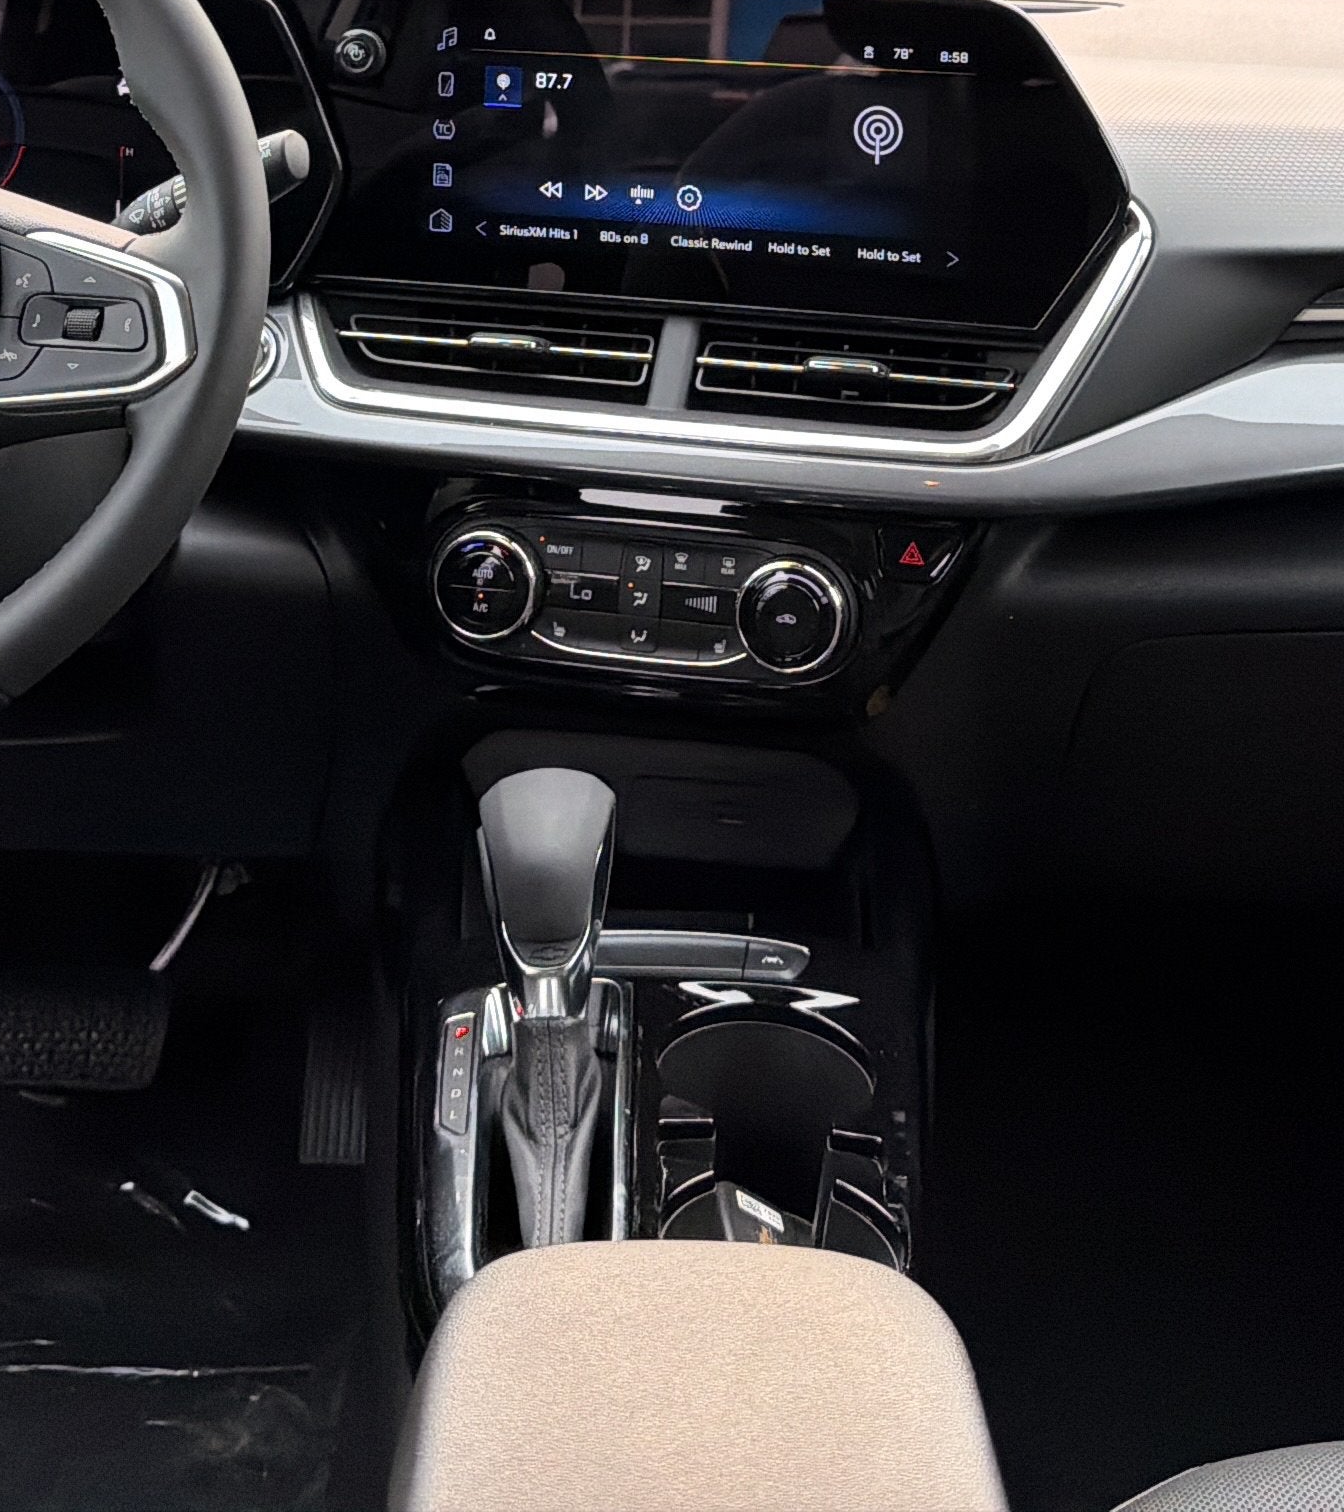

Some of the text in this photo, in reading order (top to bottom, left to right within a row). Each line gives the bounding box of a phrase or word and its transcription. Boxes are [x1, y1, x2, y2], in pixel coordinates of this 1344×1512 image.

[939, 51, 969, 64] 8:58
[535, 72, 573, 90] 87.7
[125, 147, 134, 157] H
[498, 224, 578, 241] SiriusXM Hits 1
[599, 230, 649, 245] 80s on 8
[670, 235, 752, 252] Classic Rewind
[767, 242, 831, 258] Hold to Set
[856, 248, 921, 264] Hold to Set
[546, 544, 574, 555] ON/OFF
[471, 569, 494, 579] AUTO
[472, 602, 489, 613] A/C
[452, 1068, 464, 1077] N
[450, 1089, 462, 1099] D
[449, 1110, 458, 1121] L
